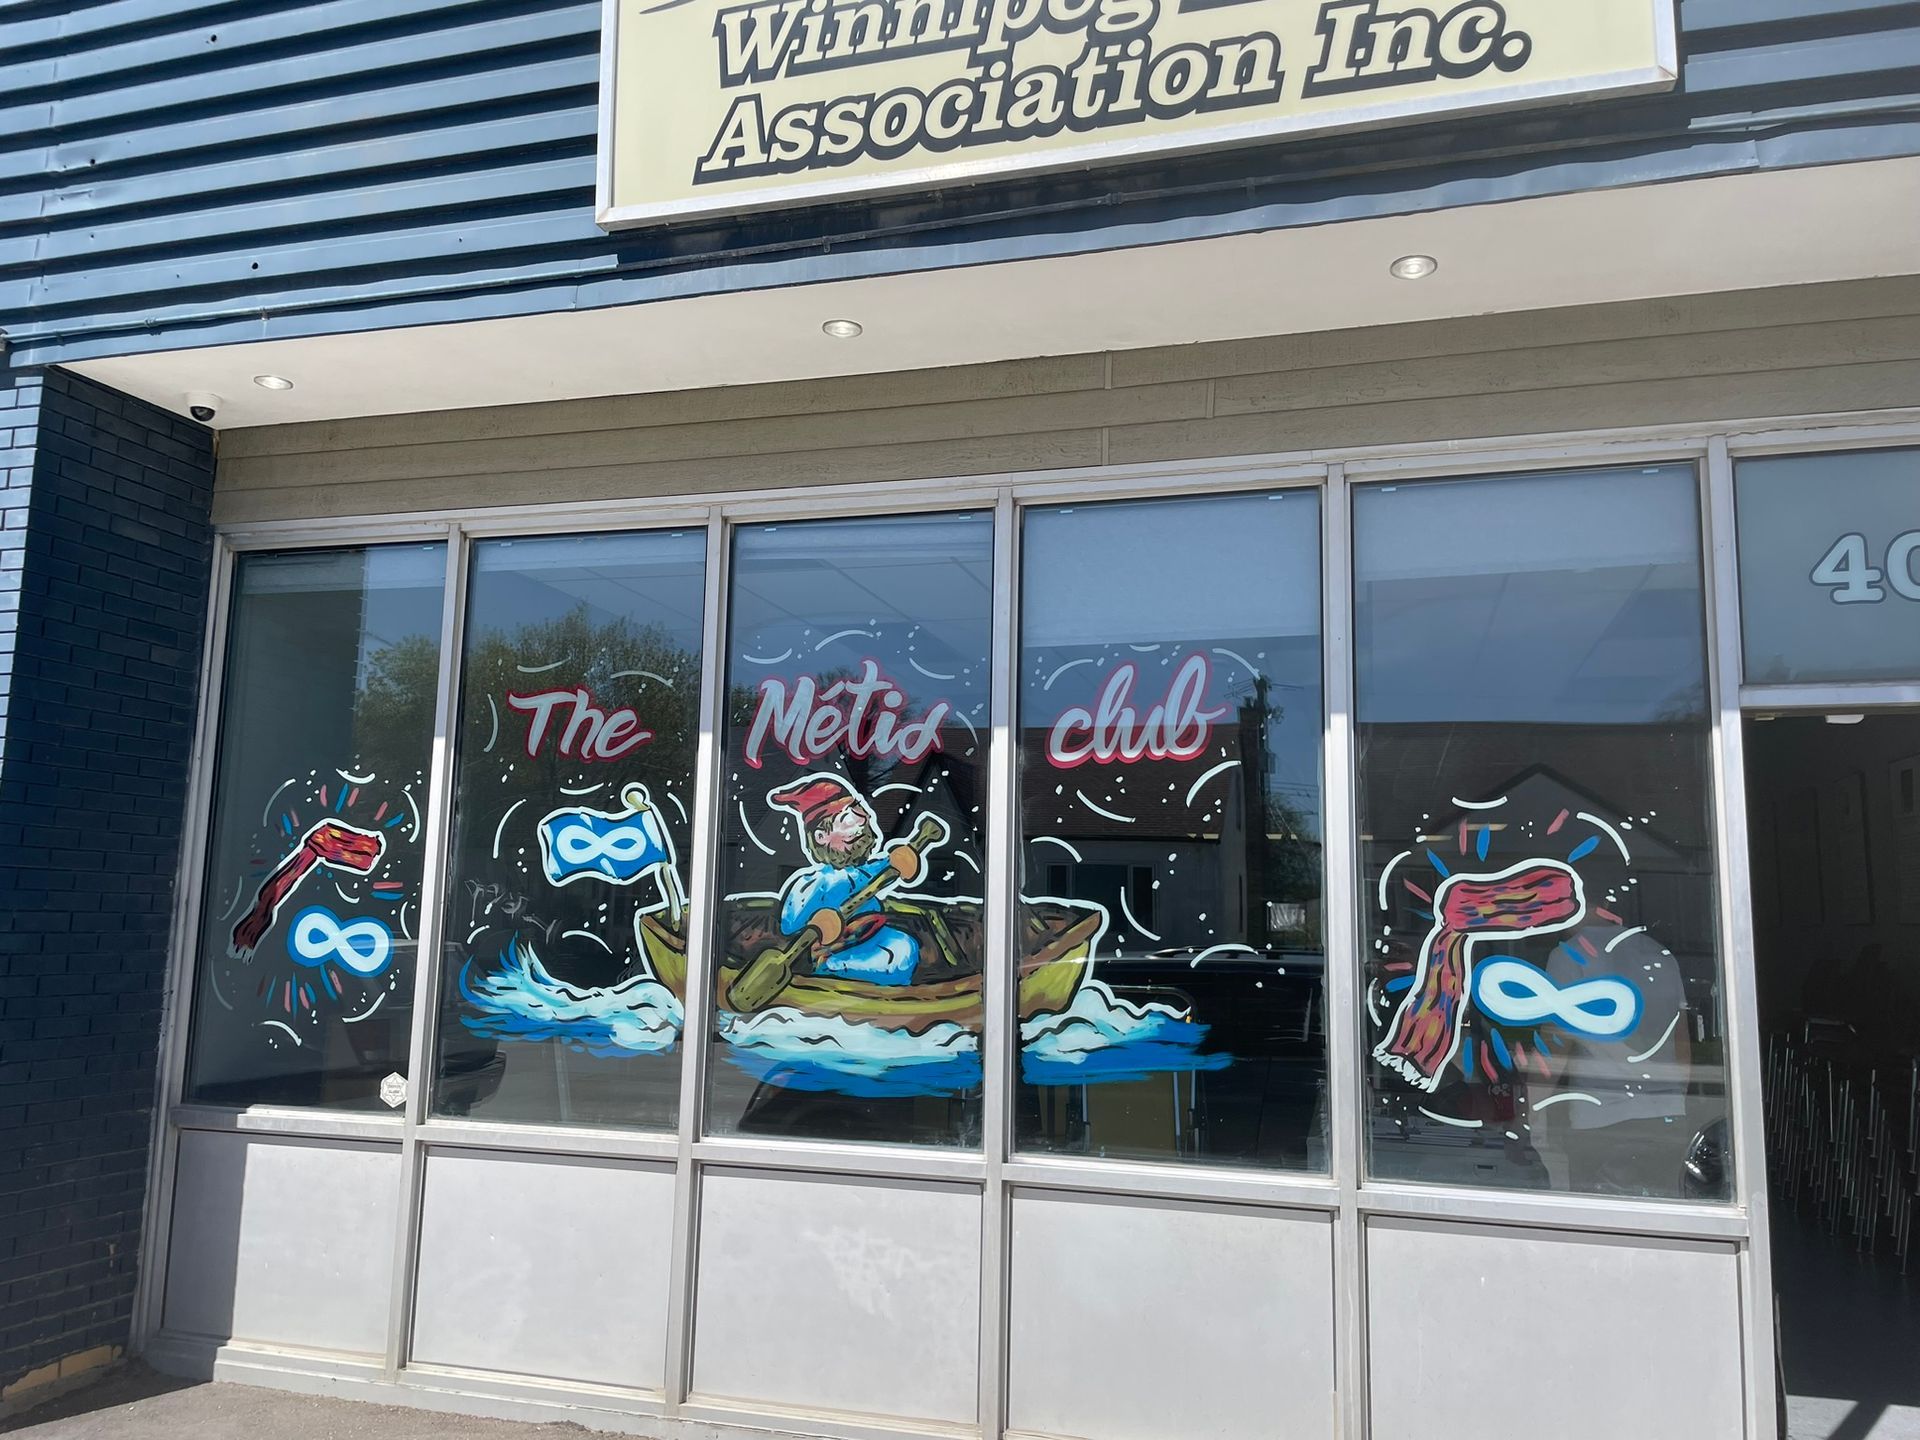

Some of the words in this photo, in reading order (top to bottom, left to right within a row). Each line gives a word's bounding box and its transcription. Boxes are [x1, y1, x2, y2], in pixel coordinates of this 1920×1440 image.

[693, 37, 1285, 185] Association
[1300, 0, 1532, 99] Inc.
[506, 684, 655, 764] The
[744, 658, 951, 769] Métis
[1044, 651, 1232, 769] club
